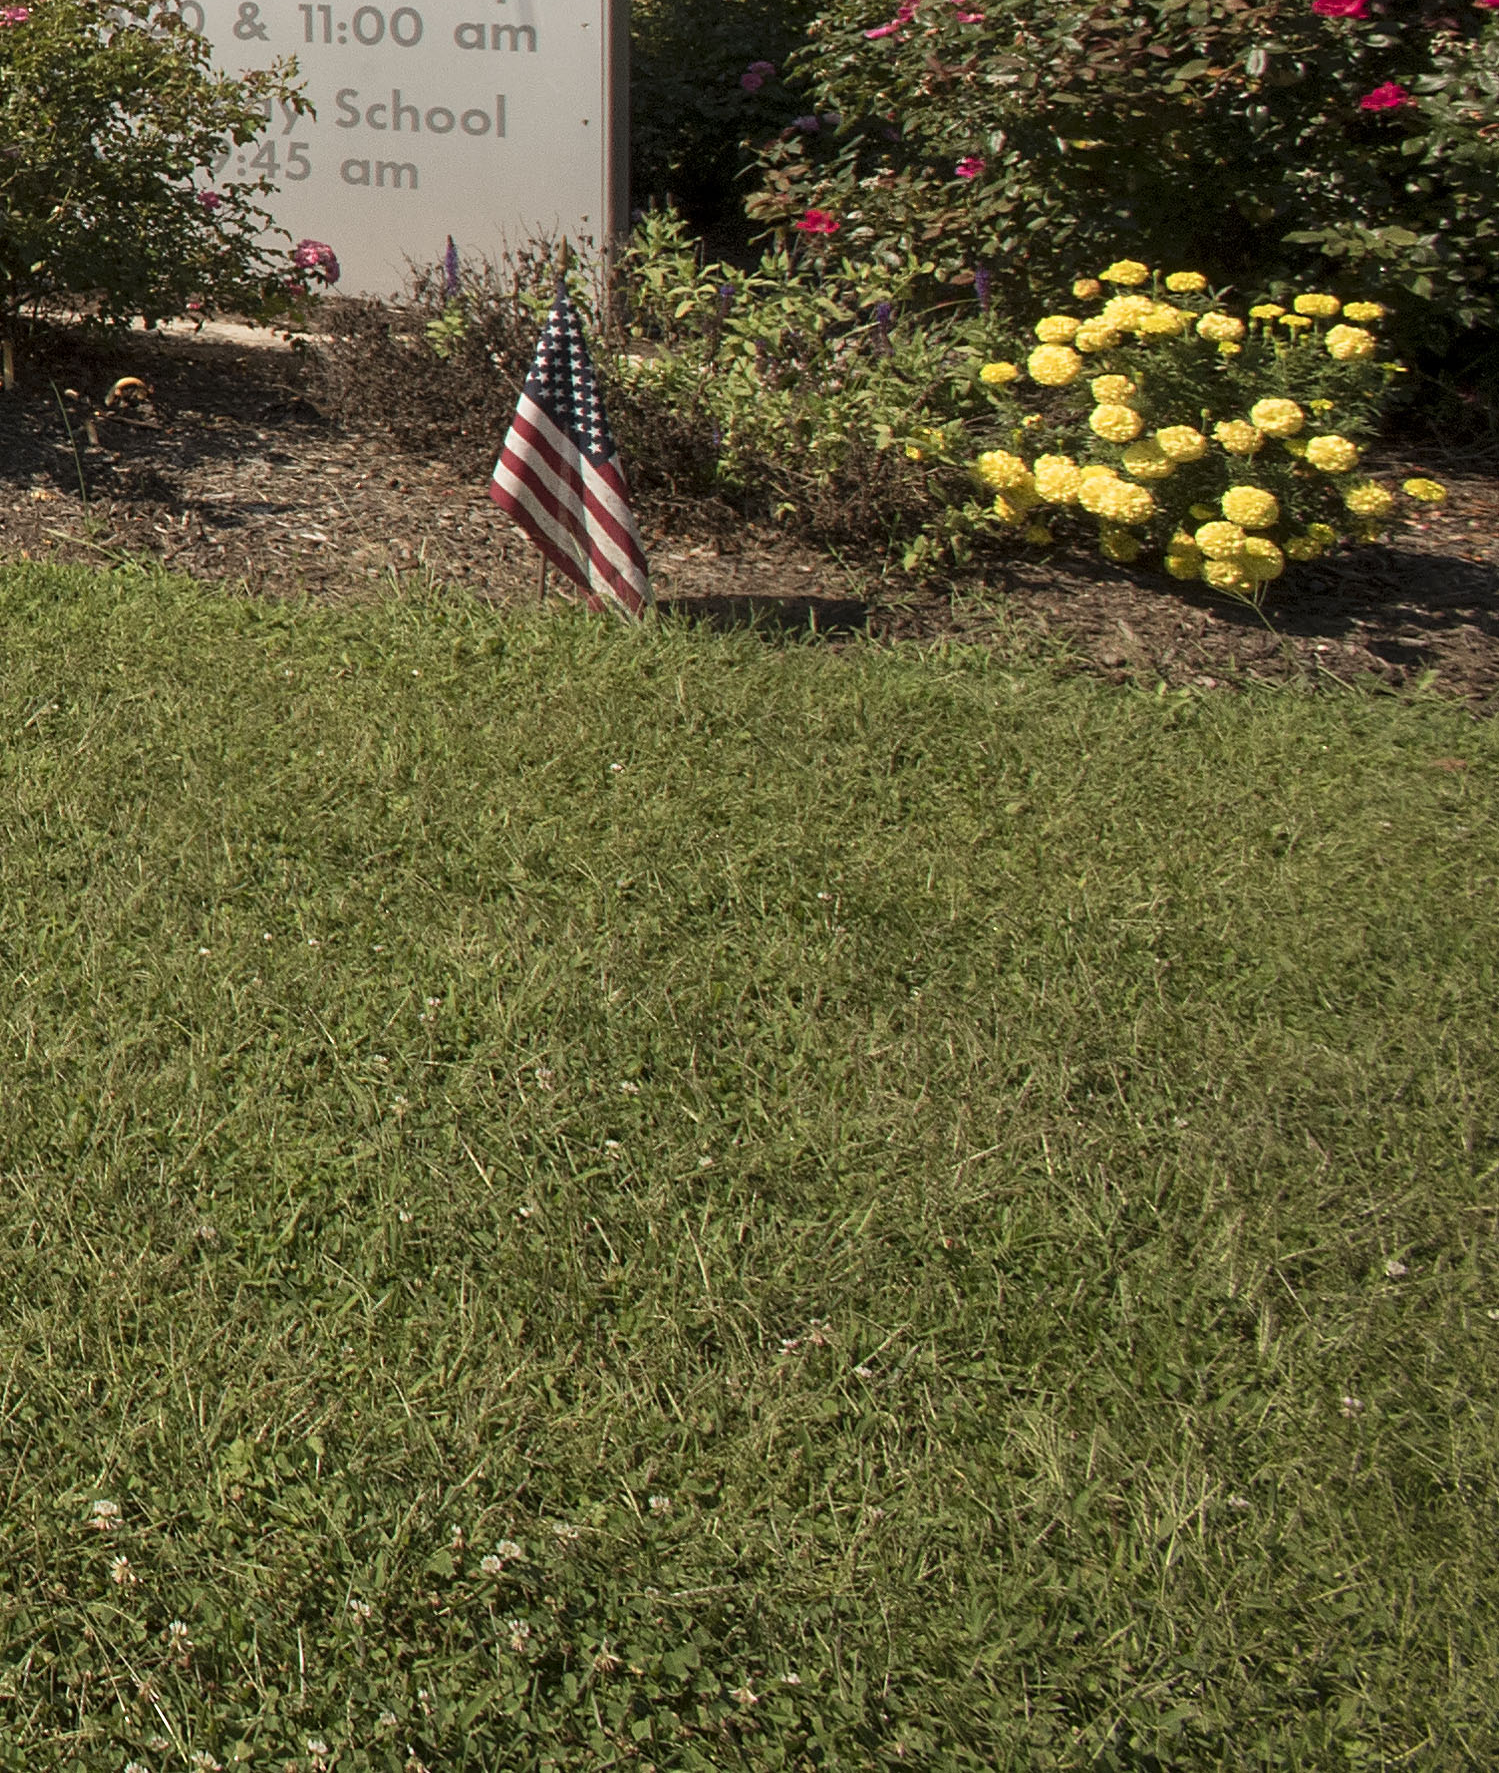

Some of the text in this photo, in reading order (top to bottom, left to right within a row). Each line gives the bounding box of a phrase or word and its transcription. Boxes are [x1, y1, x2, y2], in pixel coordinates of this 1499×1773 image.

[232, 1, 270, 41] &
[298, 3, 424, 48] 11:00
[453, 21, 538, 53] am
[334, 88, 508, 138] School
[339, 153, 421, 190] am
